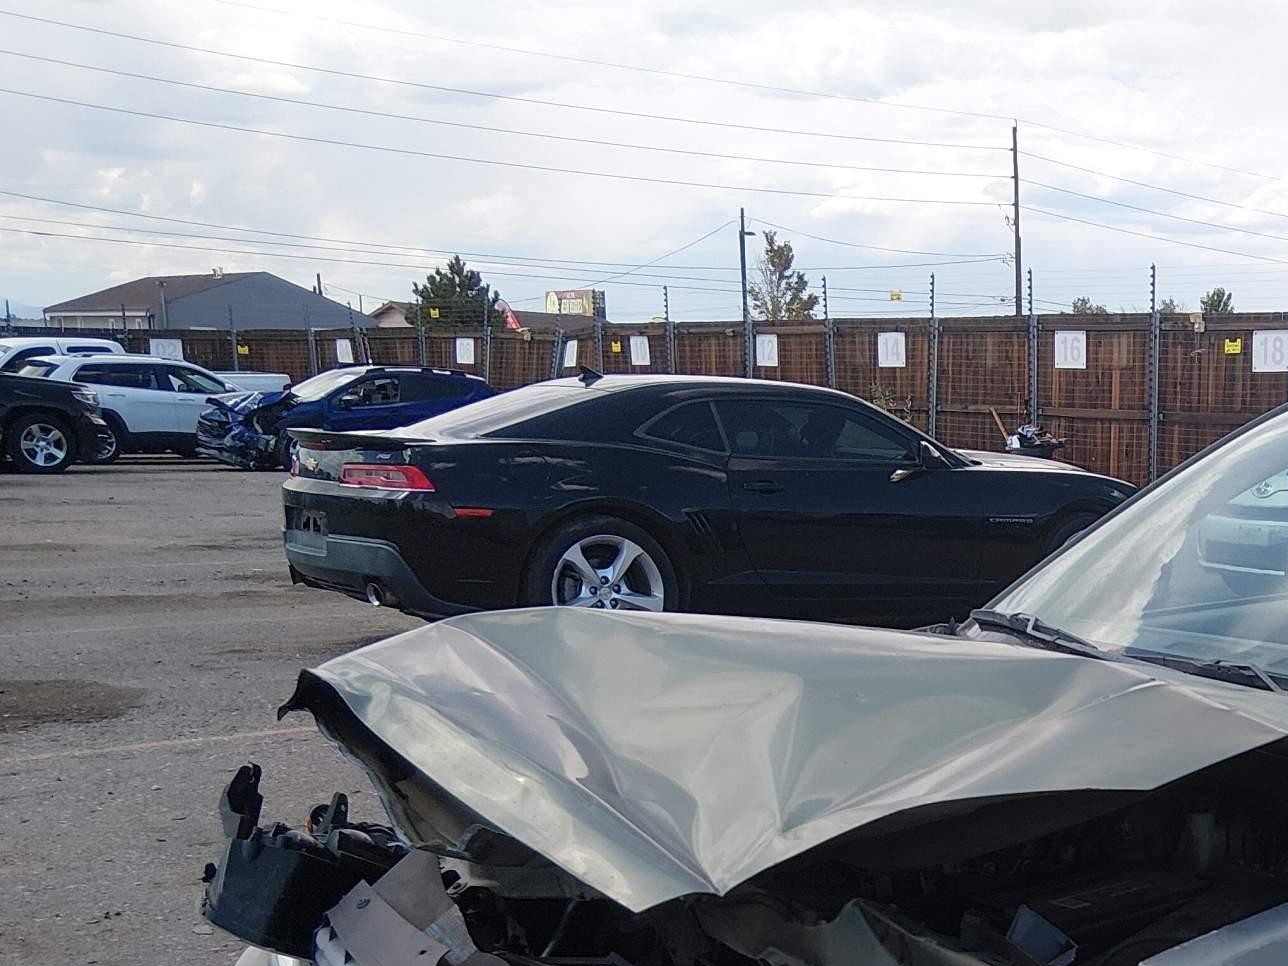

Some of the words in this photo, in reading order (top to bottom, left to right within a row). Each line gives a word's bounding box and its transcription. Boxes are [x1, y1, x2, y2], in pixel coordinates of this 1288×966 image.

[760, 339, 775, 361] 12
[883, 337, 902, 361] 14
[1061, 336, 1081, 361] 16
[1260, 336, 1284, 365] 18
